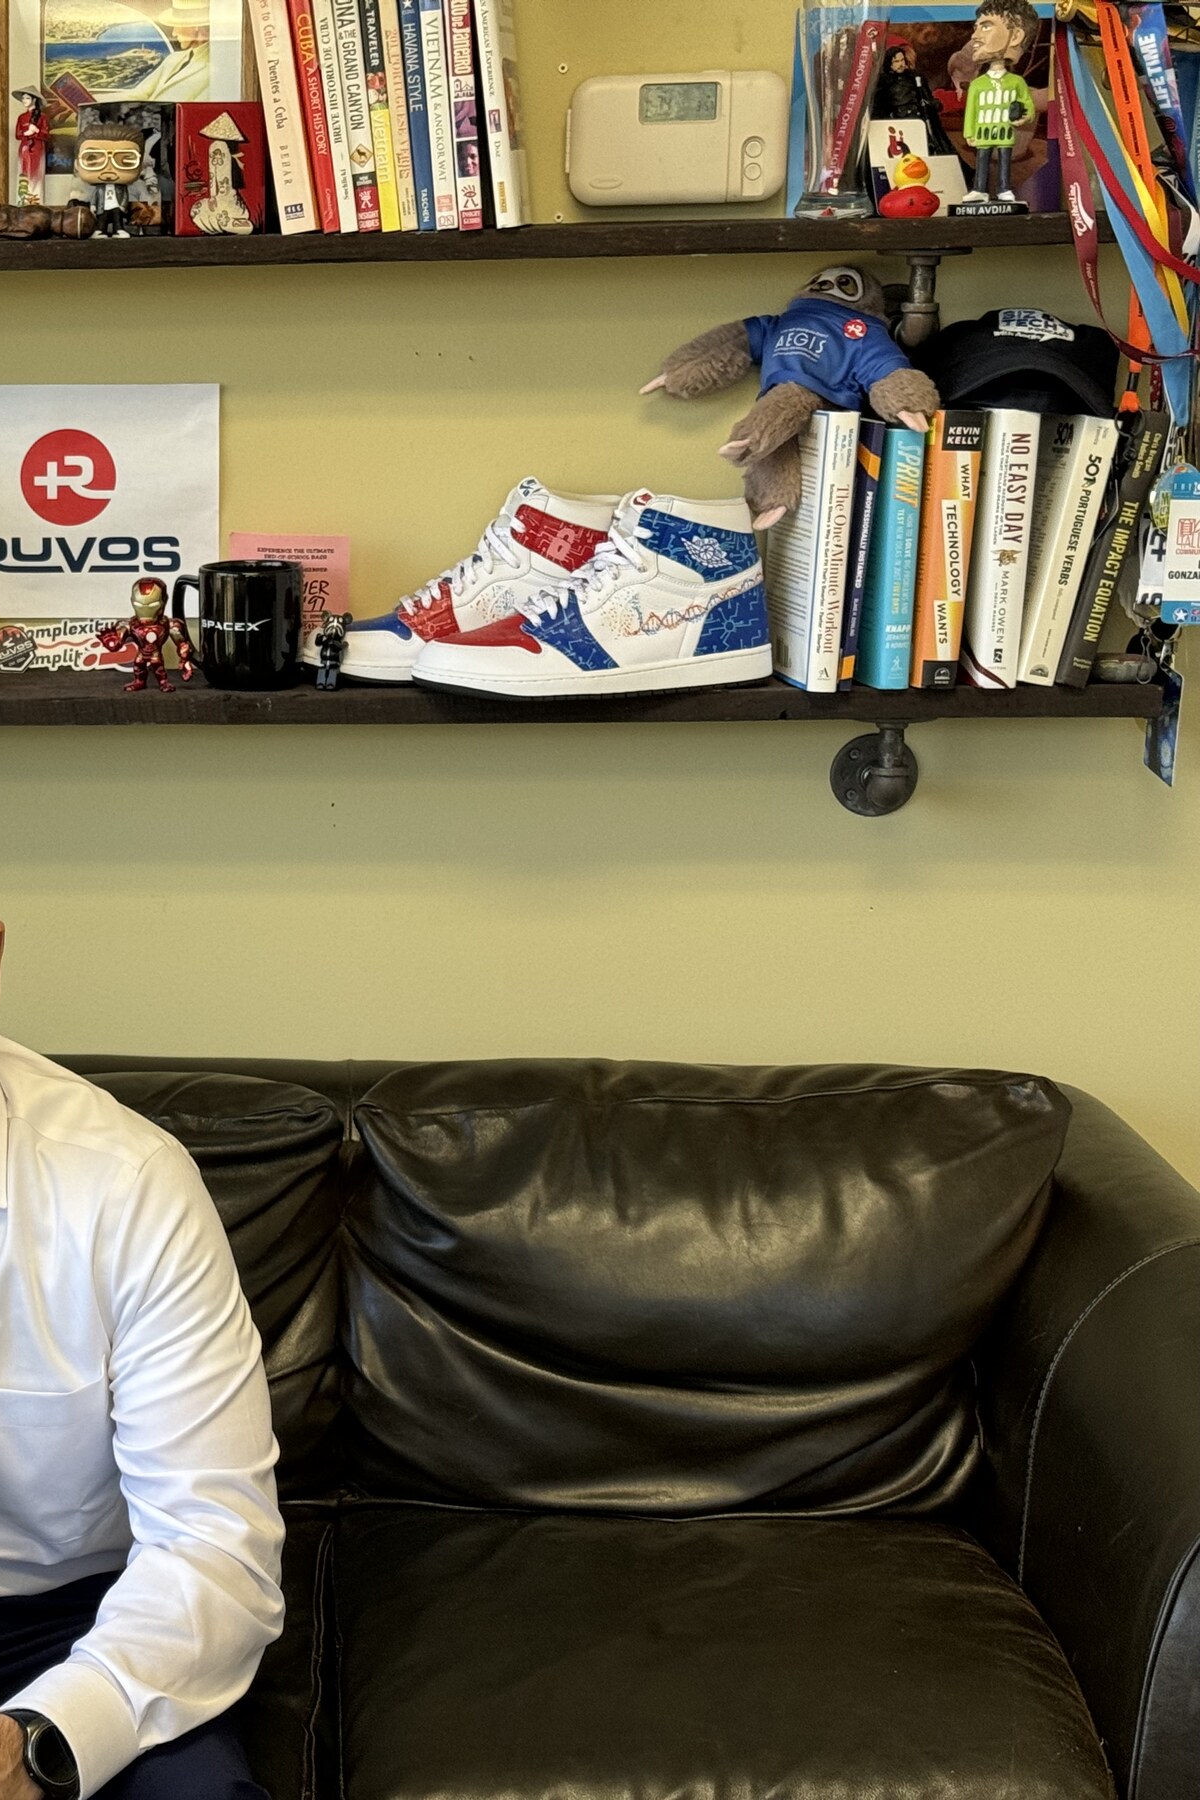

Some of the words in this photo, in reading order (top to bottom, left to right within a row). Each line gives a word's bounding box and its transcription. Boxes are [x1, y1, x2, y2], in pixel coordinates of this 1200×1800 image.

[263, 24, 277, 48] Cuba
[296, 13, 316, 65] CUBA
[319, 17, 331, 44] CUBA
[365, 10, 380, 67] TRAVELER
[480, 9, 491, 49] AMERICAN
[322, 46, 334, 61] DE
[341, 41, 359, 80] GRAND
[403, 23, 419, 73] HAVANA
[425, 17, 444, 99] VIETNAM
[1137, 32, 1163, 77] TIME
[267, 58, 280, 95] Puentes
[306, 65, 318, 76] A
[484, 50, 495, 97] EXPERIENCE
[854, 45, 870, 90] REMOVE
[307, 77, 322, 111] SHORT
[325, 63, 338, 110] HISTORIA
[391, 54, 408, 136] PORTUGUESE
[407, 75, 423, 112] STYLE
[1150, 75, 1173, 110] LIFE
[274, 106, 288, 130] Cuba
[346, 83, 365, 131] CANYON
[837, 93, 858, 140] BEFORE
[312, 113, 328, 156] HISTORY
[331, 113, 343, 144] BREVE
[434, 112, 445, 159] ANGKOR
[1063, 117, 1076, 158] Excellence
[279, 144, 293, 186] BEHAR
[398, 139, 411, 179] VERBS
[437, 160, 447, 181] WAT
[420, 188, 431, 223] TASCHEN
[955, 206, 976, 216] DENI
[977, 204, 1012, 215] AVDIJA
[1002, 310, 1036, 320] BIZ
[1002, 318, 1058, 331] TECH
[774, 332, 827, 354] AEGIS
[946, 435, 980, 445] KELLY
[948, 426, 981, 436] KEVIN
[1011, 433, 1031, 454] NO
[1153, 432, 1163, 451] Chris
[895, 440, 922, 509] SPRINT
[960, 463, 971, 499] WHAT
[1007, 462, 1029, 507] EASY
[1084, 453, 1103, 486] 501
[1131, 459, 1143, 479] Smith
[835, 483, 850, 511] The
[1123, 500, 1139, 528] THE
[833, 513, 848, 542] One
[860, 490, 874, 550] PROFESSIONALLY
[898, 508, 906, 525] TEST
[1003, 511, 1025, 544] DAY
[1068, 487, 1092, 553] PORTUGUESE
[904, 539, 913, 560] SOLVE
[945, 504, 962, 597] TECHNOLOGY
[1106, 528, 1130, 581] IMPACT
[829, 549, 845, 596] Minute
[854, 549, 868, 590] DISTANCED
[1001, 570, 1009, 604] MARK
[1057, 552, 1076, 587] VERBS
[891, 595, 900, 614] DAYS
[1082, 580, 1118, 644] EQUATION
[200, 618, 272, 632] SPACEX
[822, 598, 842, 654] Workout
[885, 624, 911, 633] KNAPP
[937, 602, 948, 645] WANTS
[995, 608, 1006, 644] OWEN
